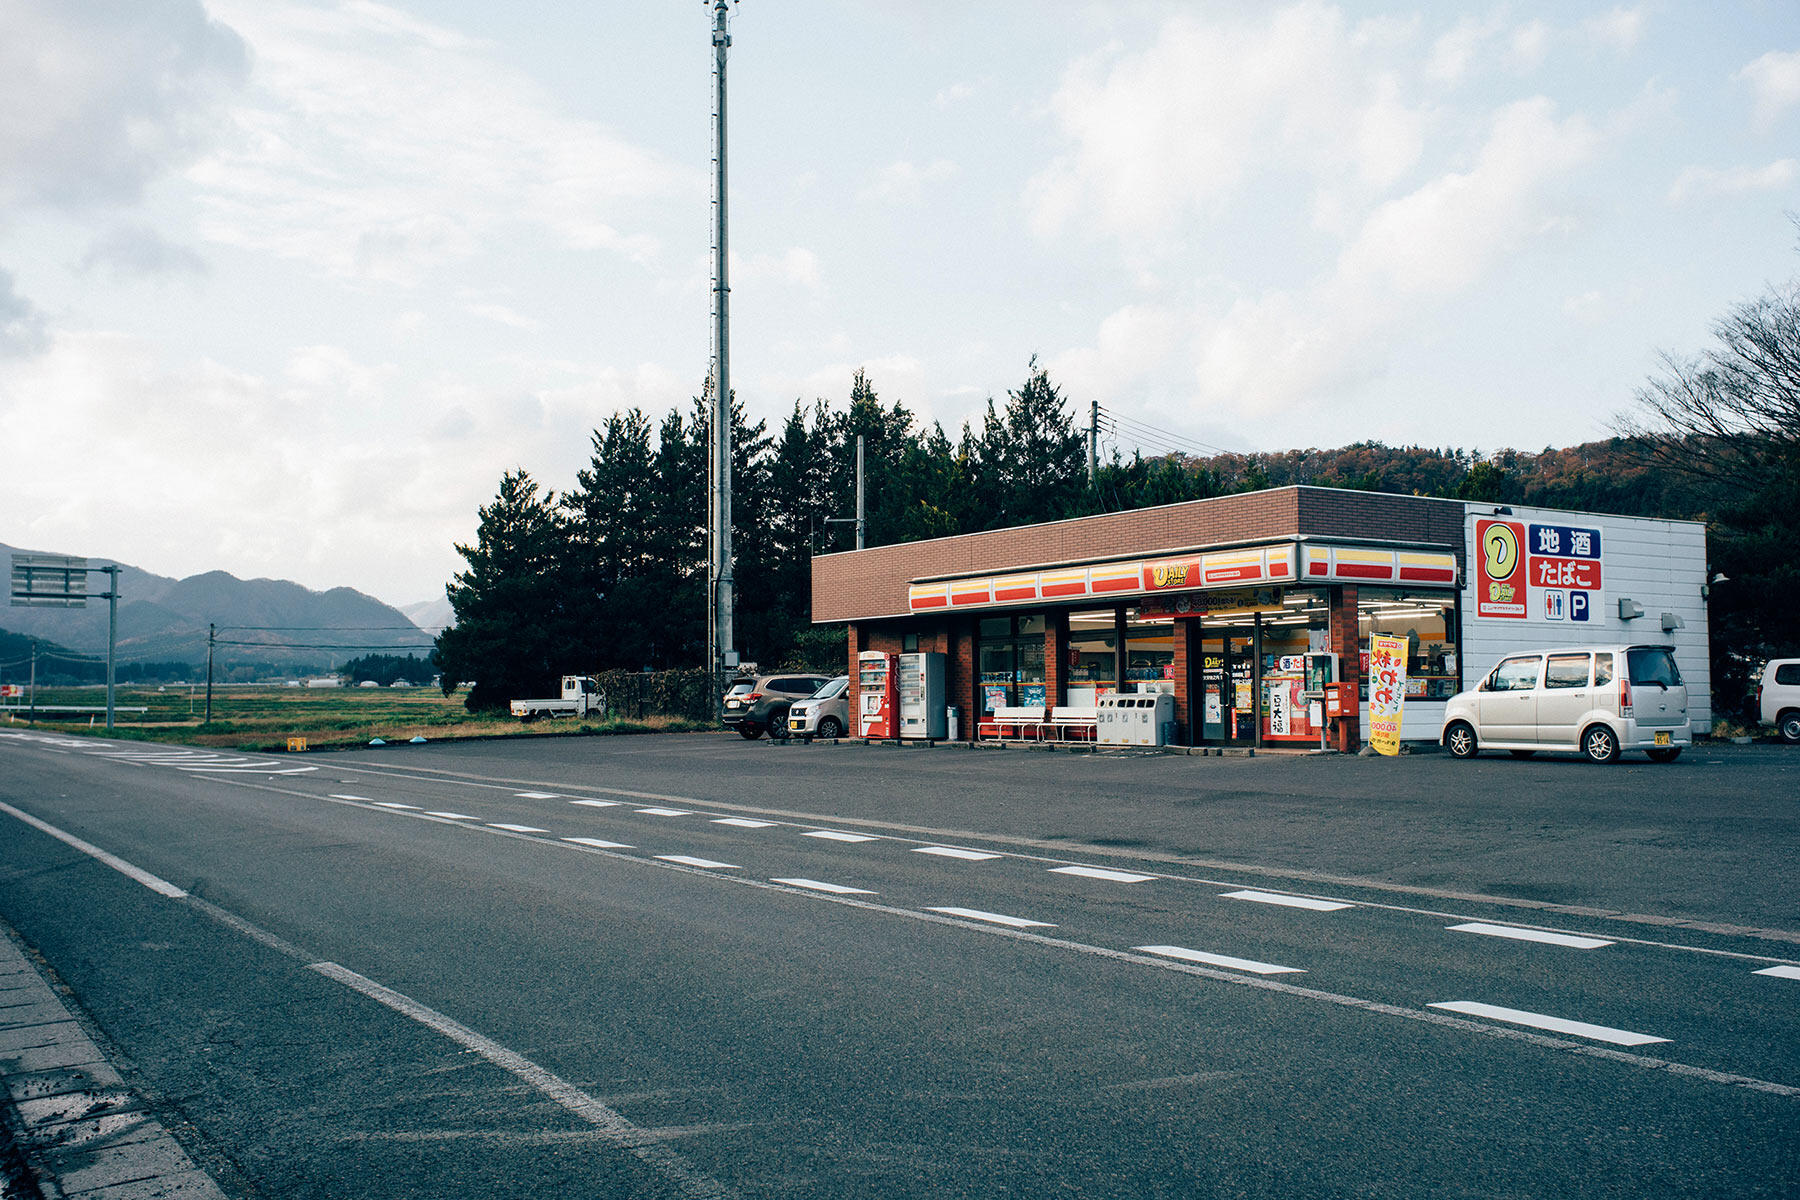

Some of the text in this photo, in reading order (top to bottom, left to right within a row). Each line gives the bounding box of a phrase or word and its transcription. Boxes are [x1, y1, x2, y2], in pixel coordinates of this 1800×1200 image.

[1538, 528, 1592, 556] 地酒
[1539, 560, 1592, 587] たばこ
[1573, 595, 1586, 617] P
